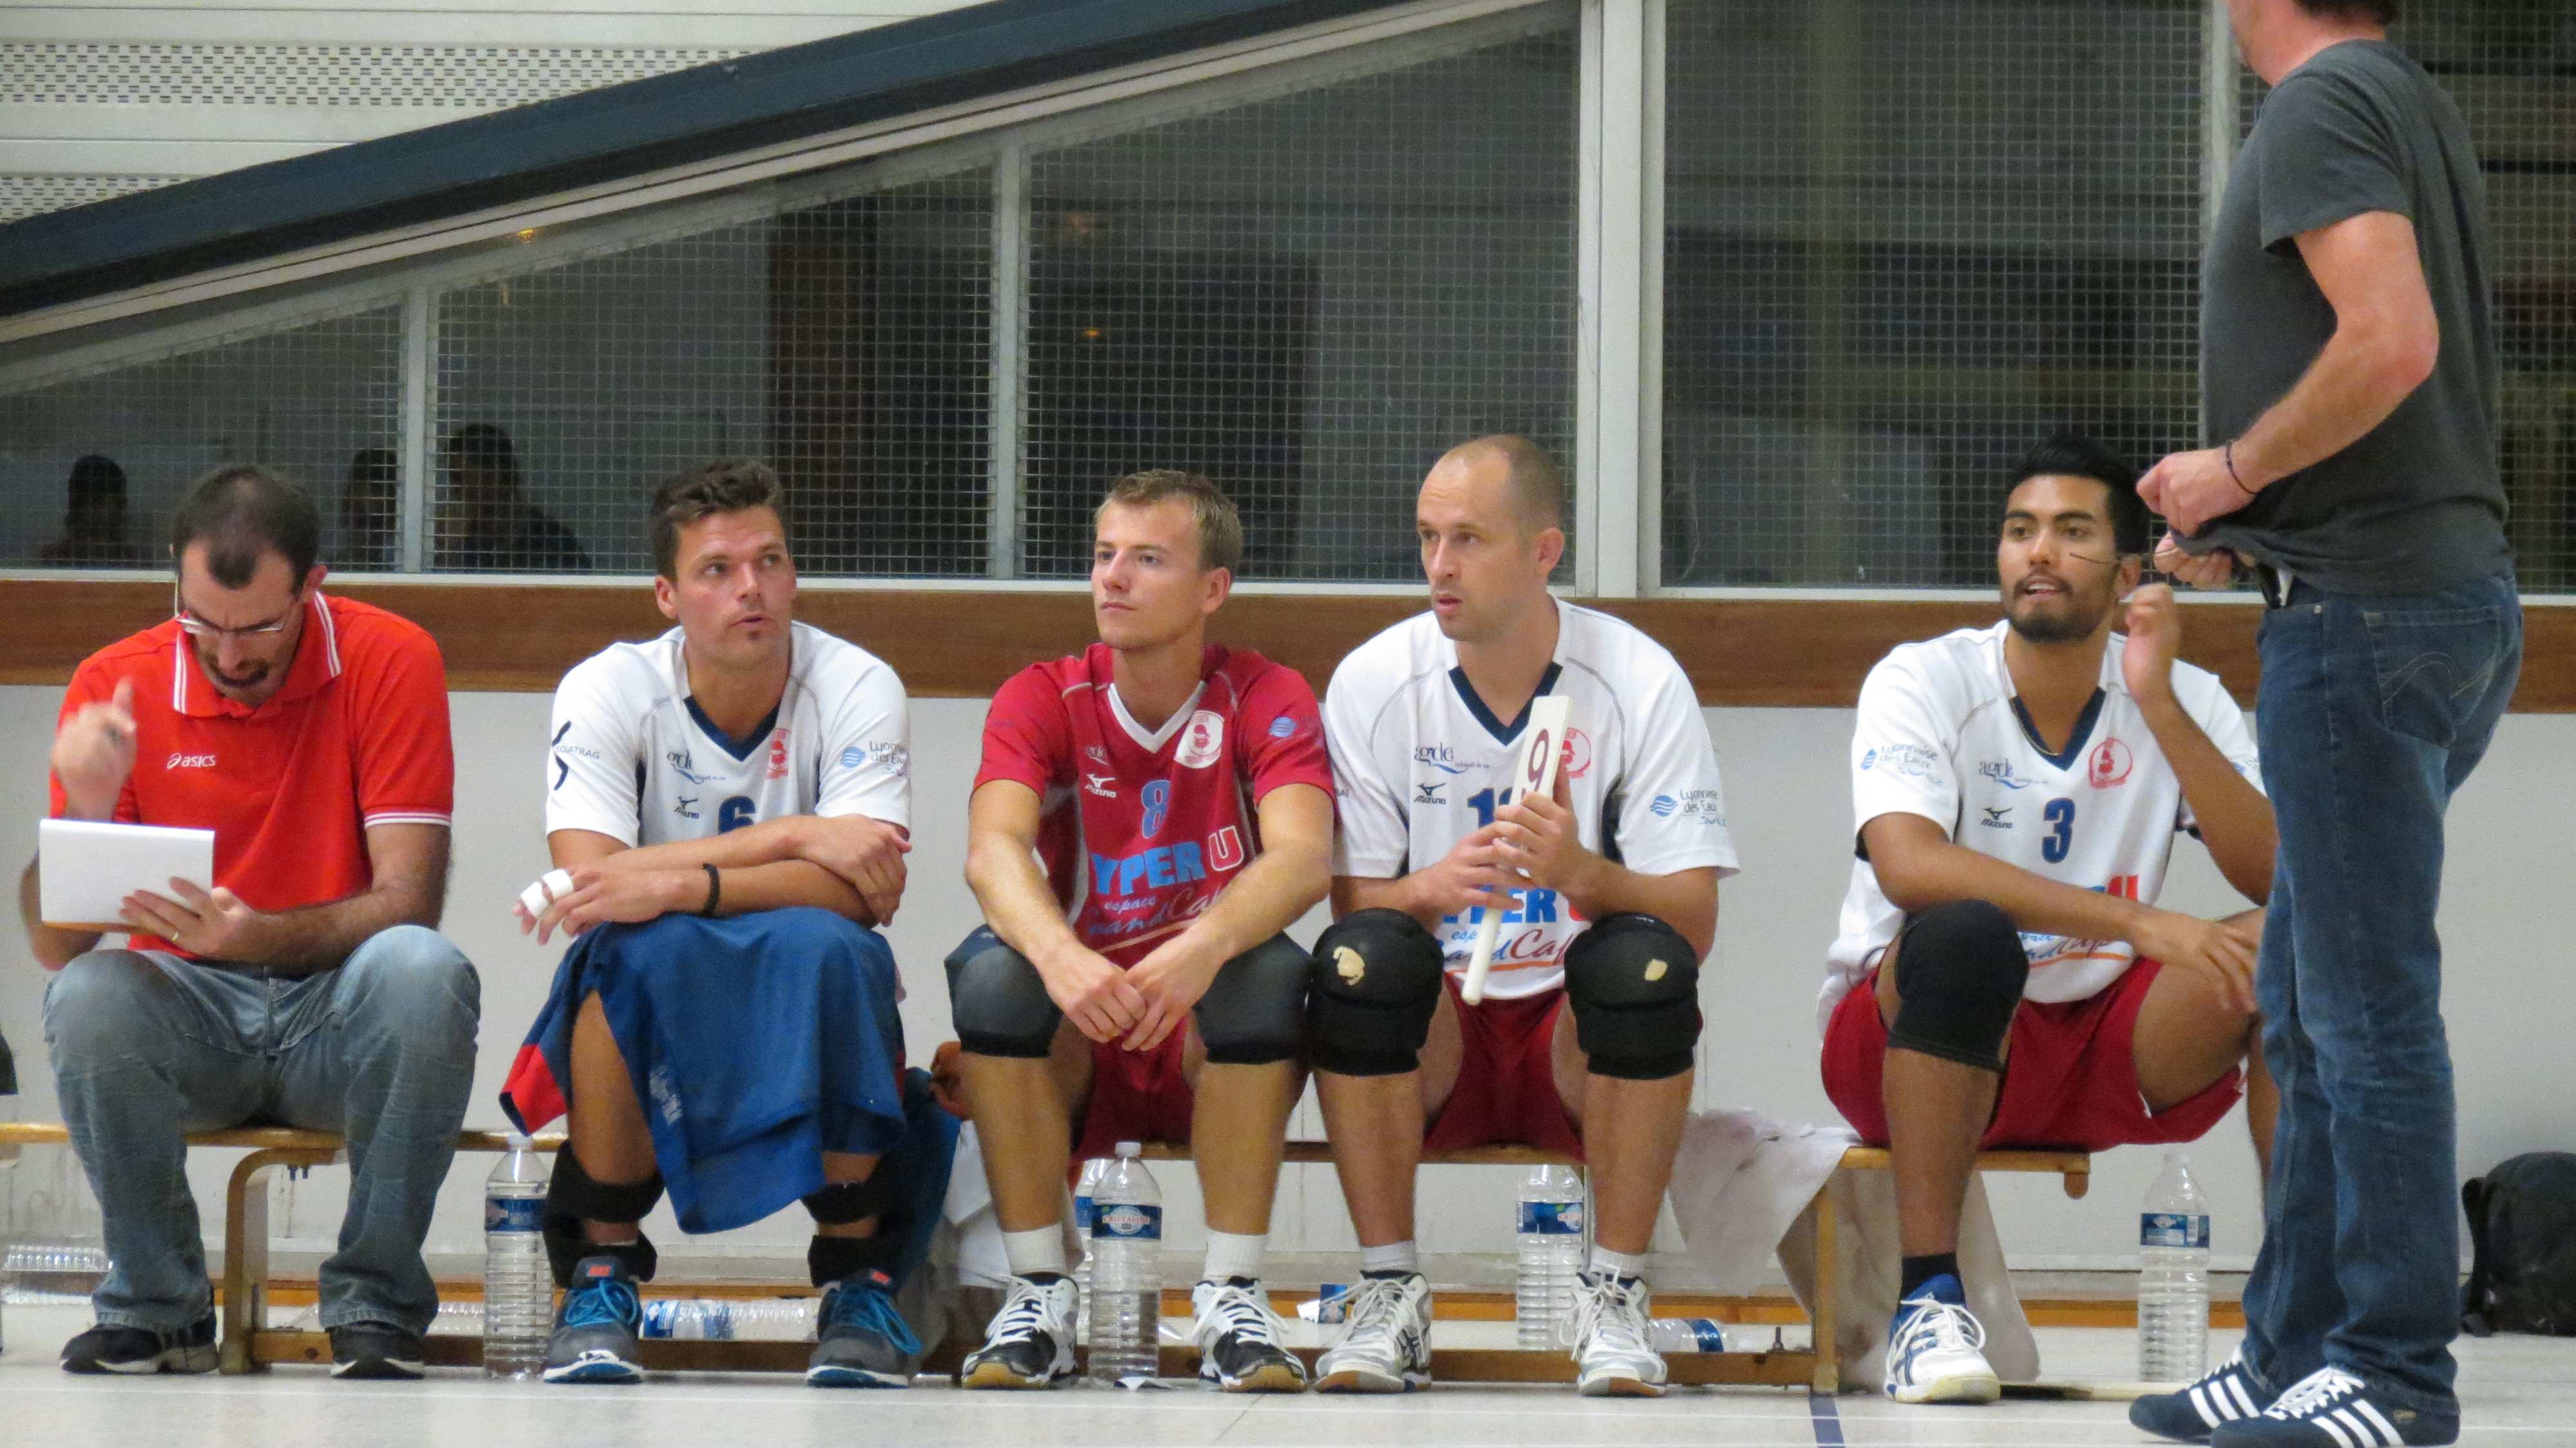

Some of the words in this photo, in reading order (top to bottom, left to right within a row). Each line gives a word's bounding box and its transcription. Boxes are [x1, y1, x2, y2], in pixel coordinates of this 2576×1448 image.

[181, 755, 216, 767] asics
[718, 795, 756, 835] 6
[1141, 779, 1170, 839] 8
[2042, 797, 2076, 864] 3
[1092, 842, 1207, 897] YPER
[1208, 825, 1244, 872] U
